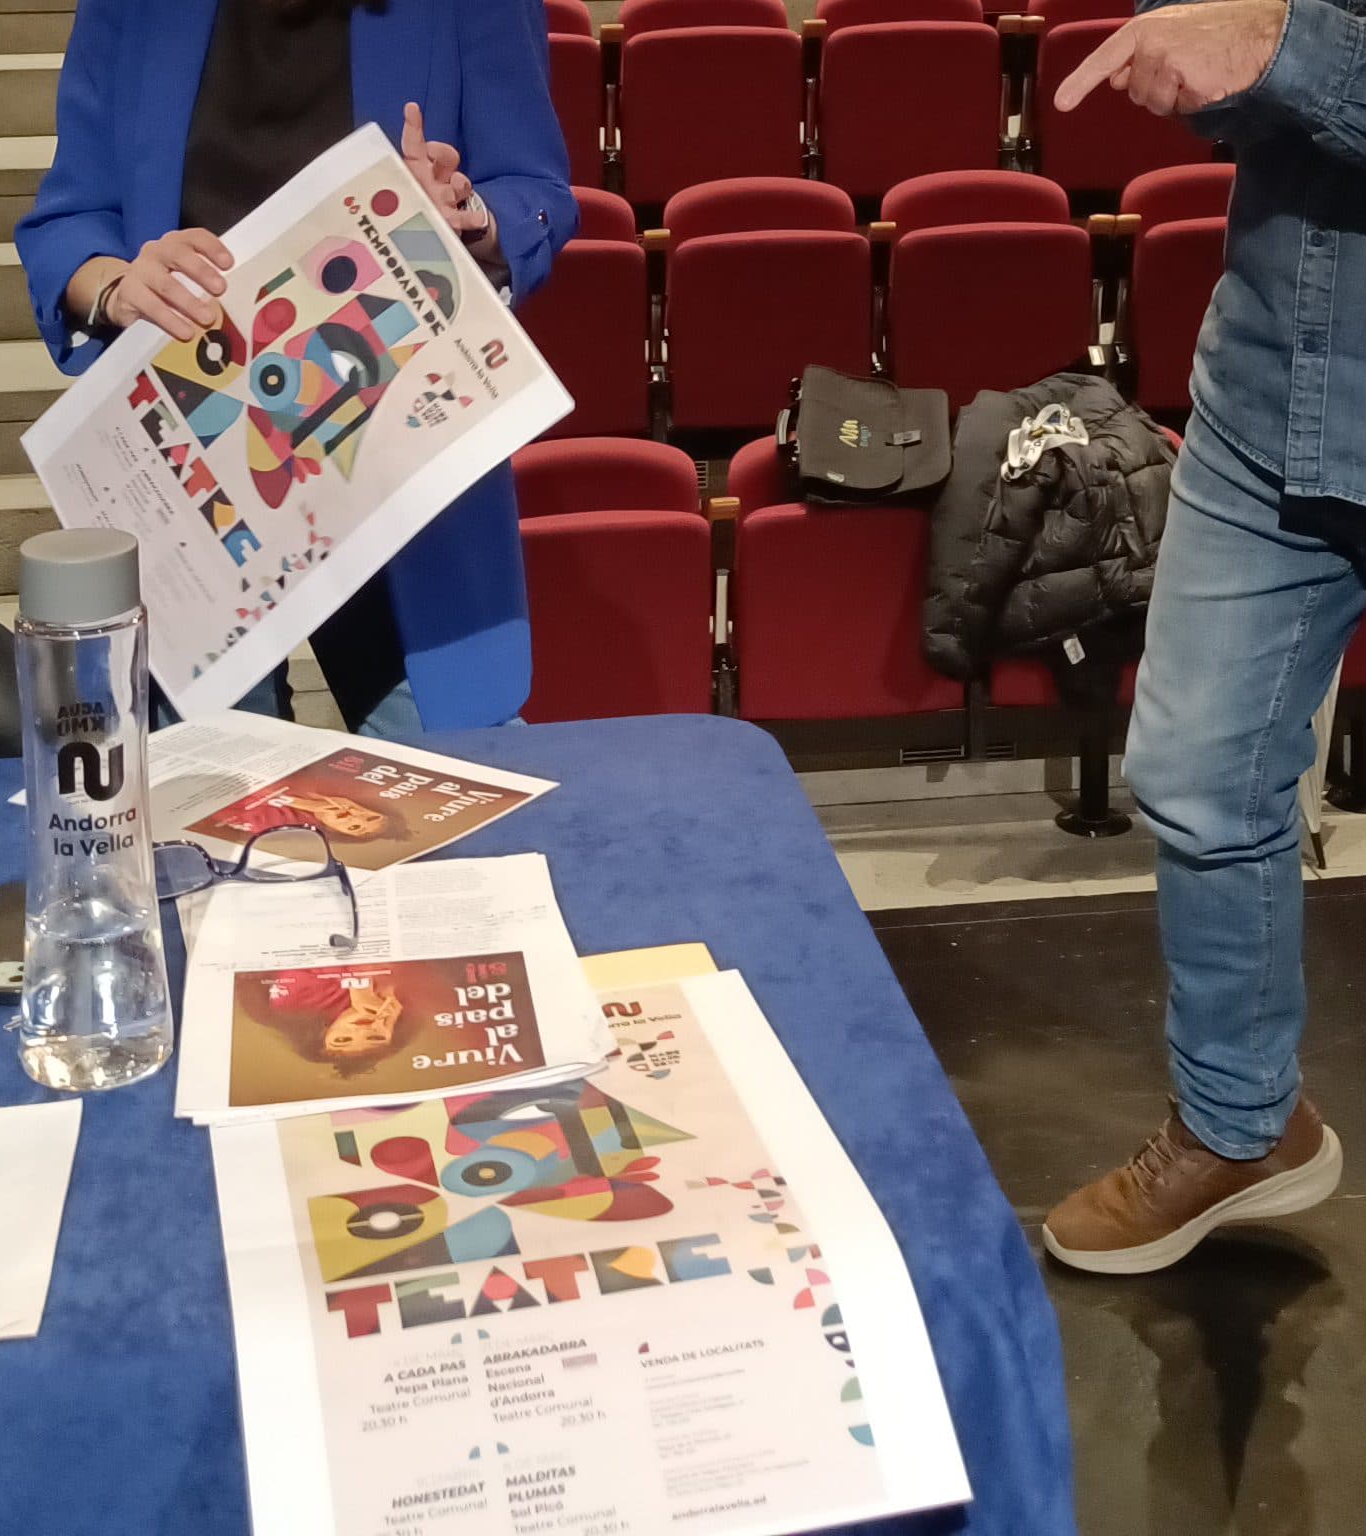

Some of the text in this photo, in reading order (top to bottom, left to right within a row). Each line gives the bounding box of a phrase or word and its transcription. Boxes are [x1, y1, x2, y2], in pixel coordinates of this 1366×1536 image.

[357, 215, 427, 311] TEMPORADA
[424, 310, 446, 336] DE
[127, 370, 262, 568] TEATRE
[354, 765, 400, 786] del
[431, 781, 463, 797] al
[423, 788, 504, 823] Viure
[49, 808, 136, 832] Andorra
[53, 833, 134, 857] la Vella
[453, 982, 512, 1007] del
[483, 1023, 519, 1047] al
[412, 1042, 523, 1070] Viure
[325, 1233, 732, 1339] TEATRE
[483, 1338, 588, 1365] ABRAKADABRA
[700, 1339, 765, 1358] LOCALITATS
[384, 1359, 466, 1383] A CADA PAS
[485, 1363, 532, 1379] Escena
[395, 1378, 428, 1395] Pepa
[487, 1375, 545, 1394] Nacional
[370, 1388, 472, 1414] Teatre Comunal
[491, 1388, 556, 1408] d'Andorra
[493, 1396, 594, 1424] Teatre Comunal
[506, 1465, 576, 1488] MALDITAS
[392, 1480, 485, 1509] HONESTEDAT
[508, 1483, 565, 1504] PLUMAS
